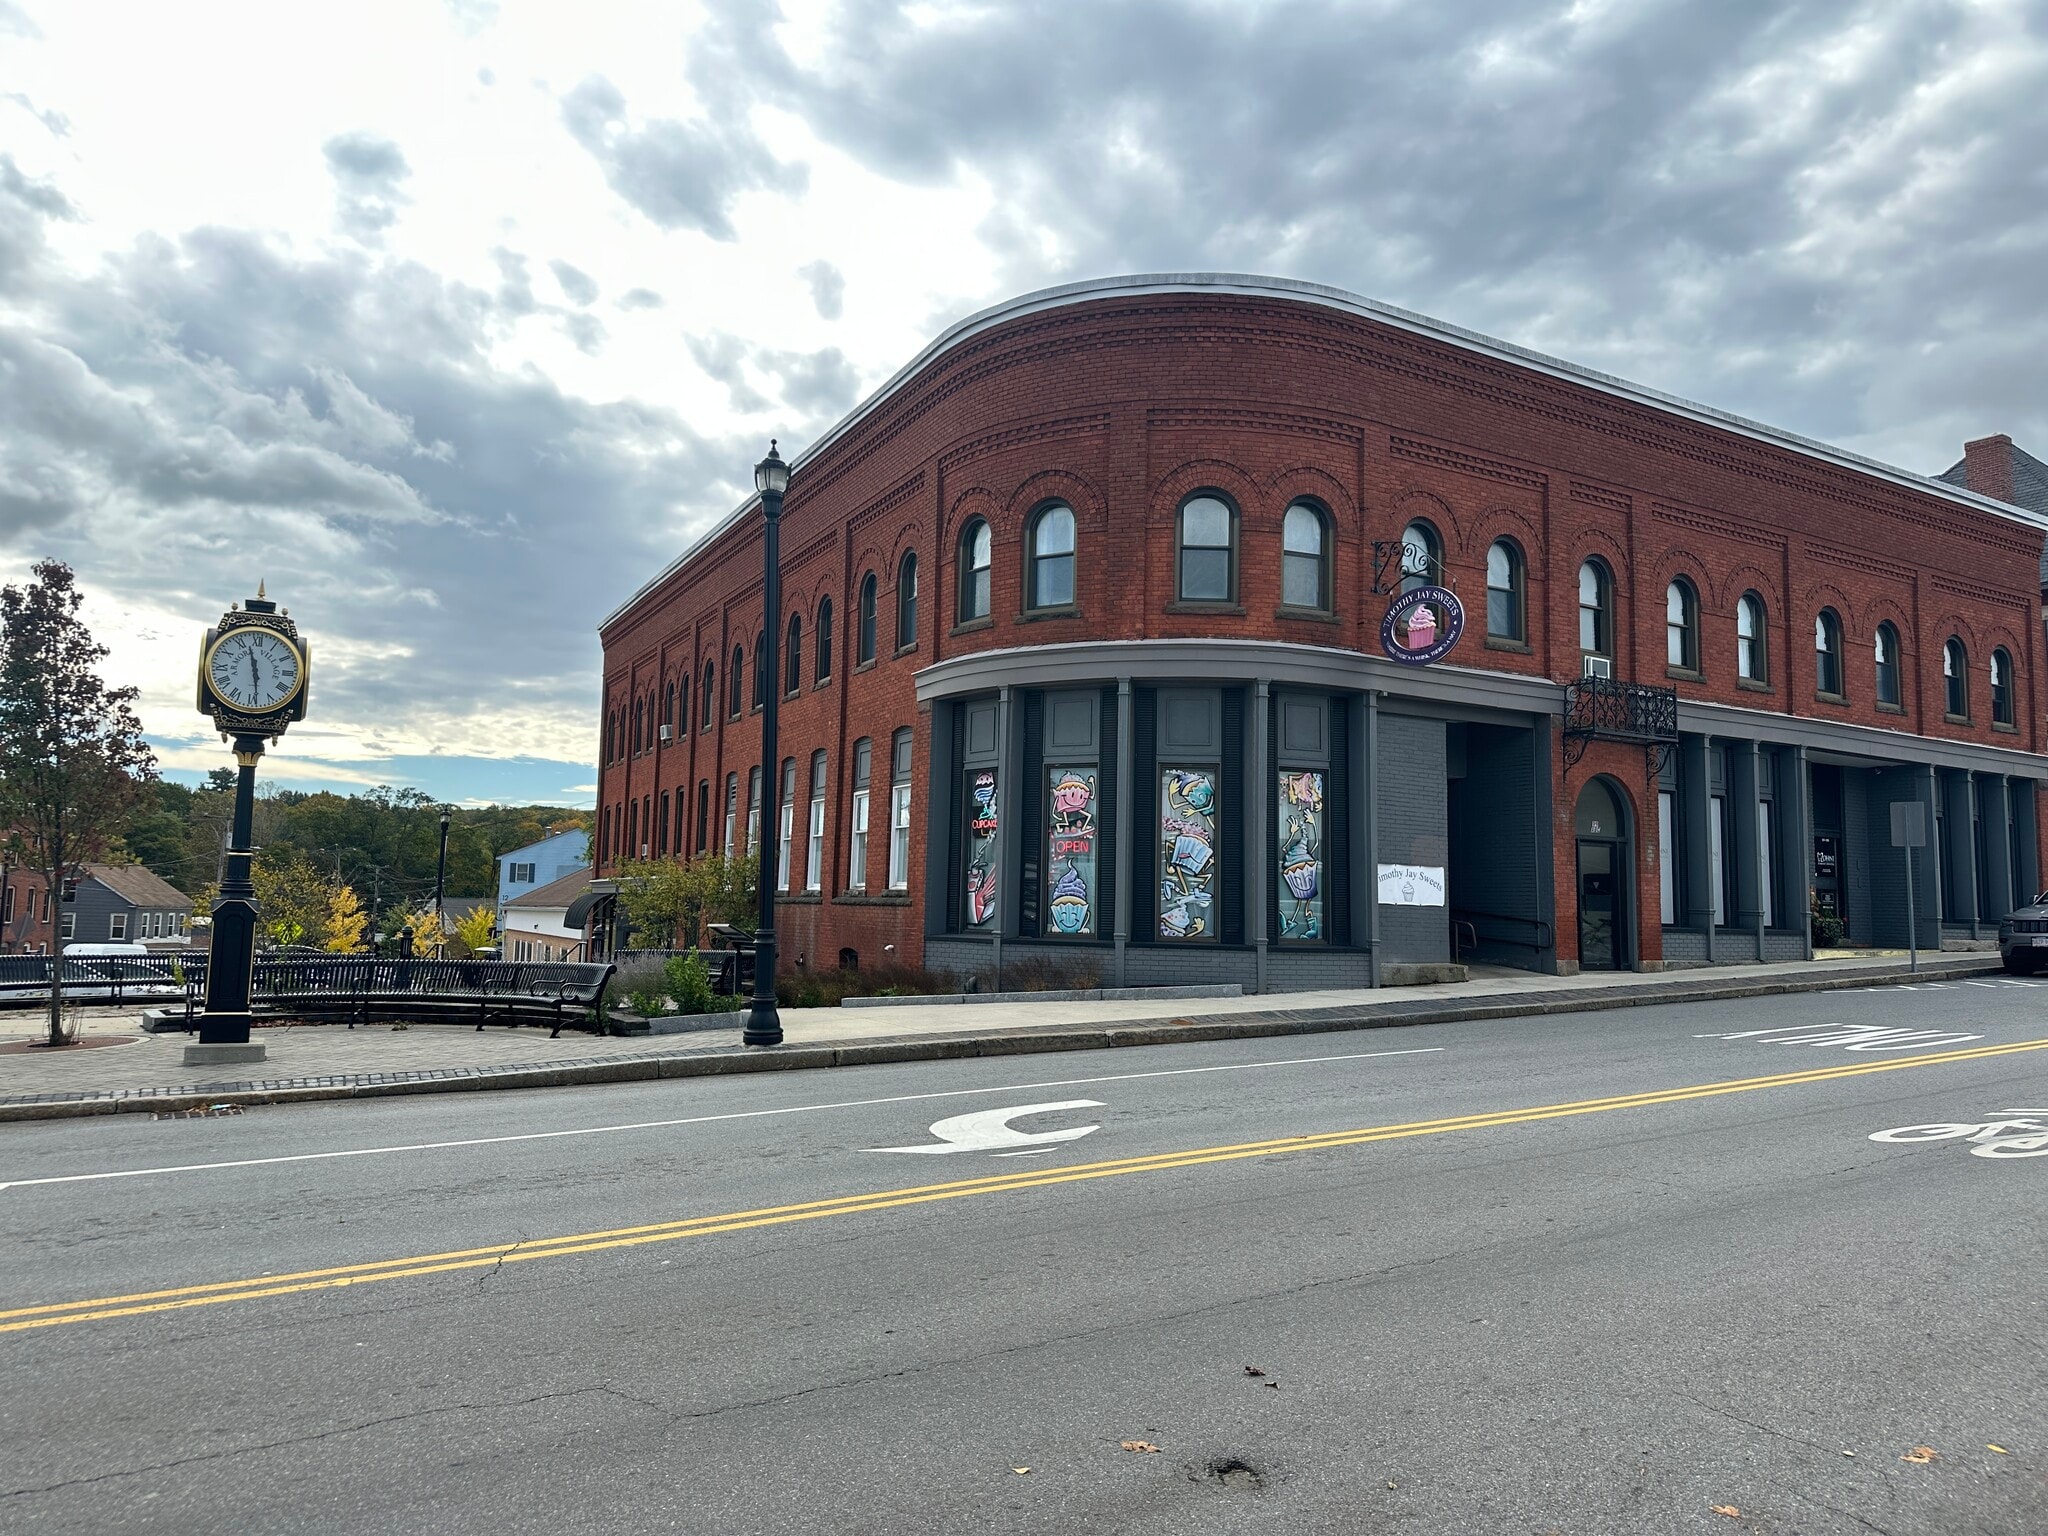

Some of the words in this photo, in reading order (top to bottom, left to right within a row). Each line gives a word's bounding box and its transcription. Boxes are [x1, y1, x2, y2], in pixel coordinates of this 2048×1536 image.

[1383, 594, 1414, 627] TIMOTHY
[1415, 590, 1431, 601] JAY
[1432, 591, 1459, 616] SWEETS
[260, 649, 281, 681] VILLAGE
[1056, 840, 1089, 853] OPEN
[1378, 868, 1403, 883] imothy
[1405, 868, 1418, 881] Jay
[1419, 871, 1442, 892] Sweets
